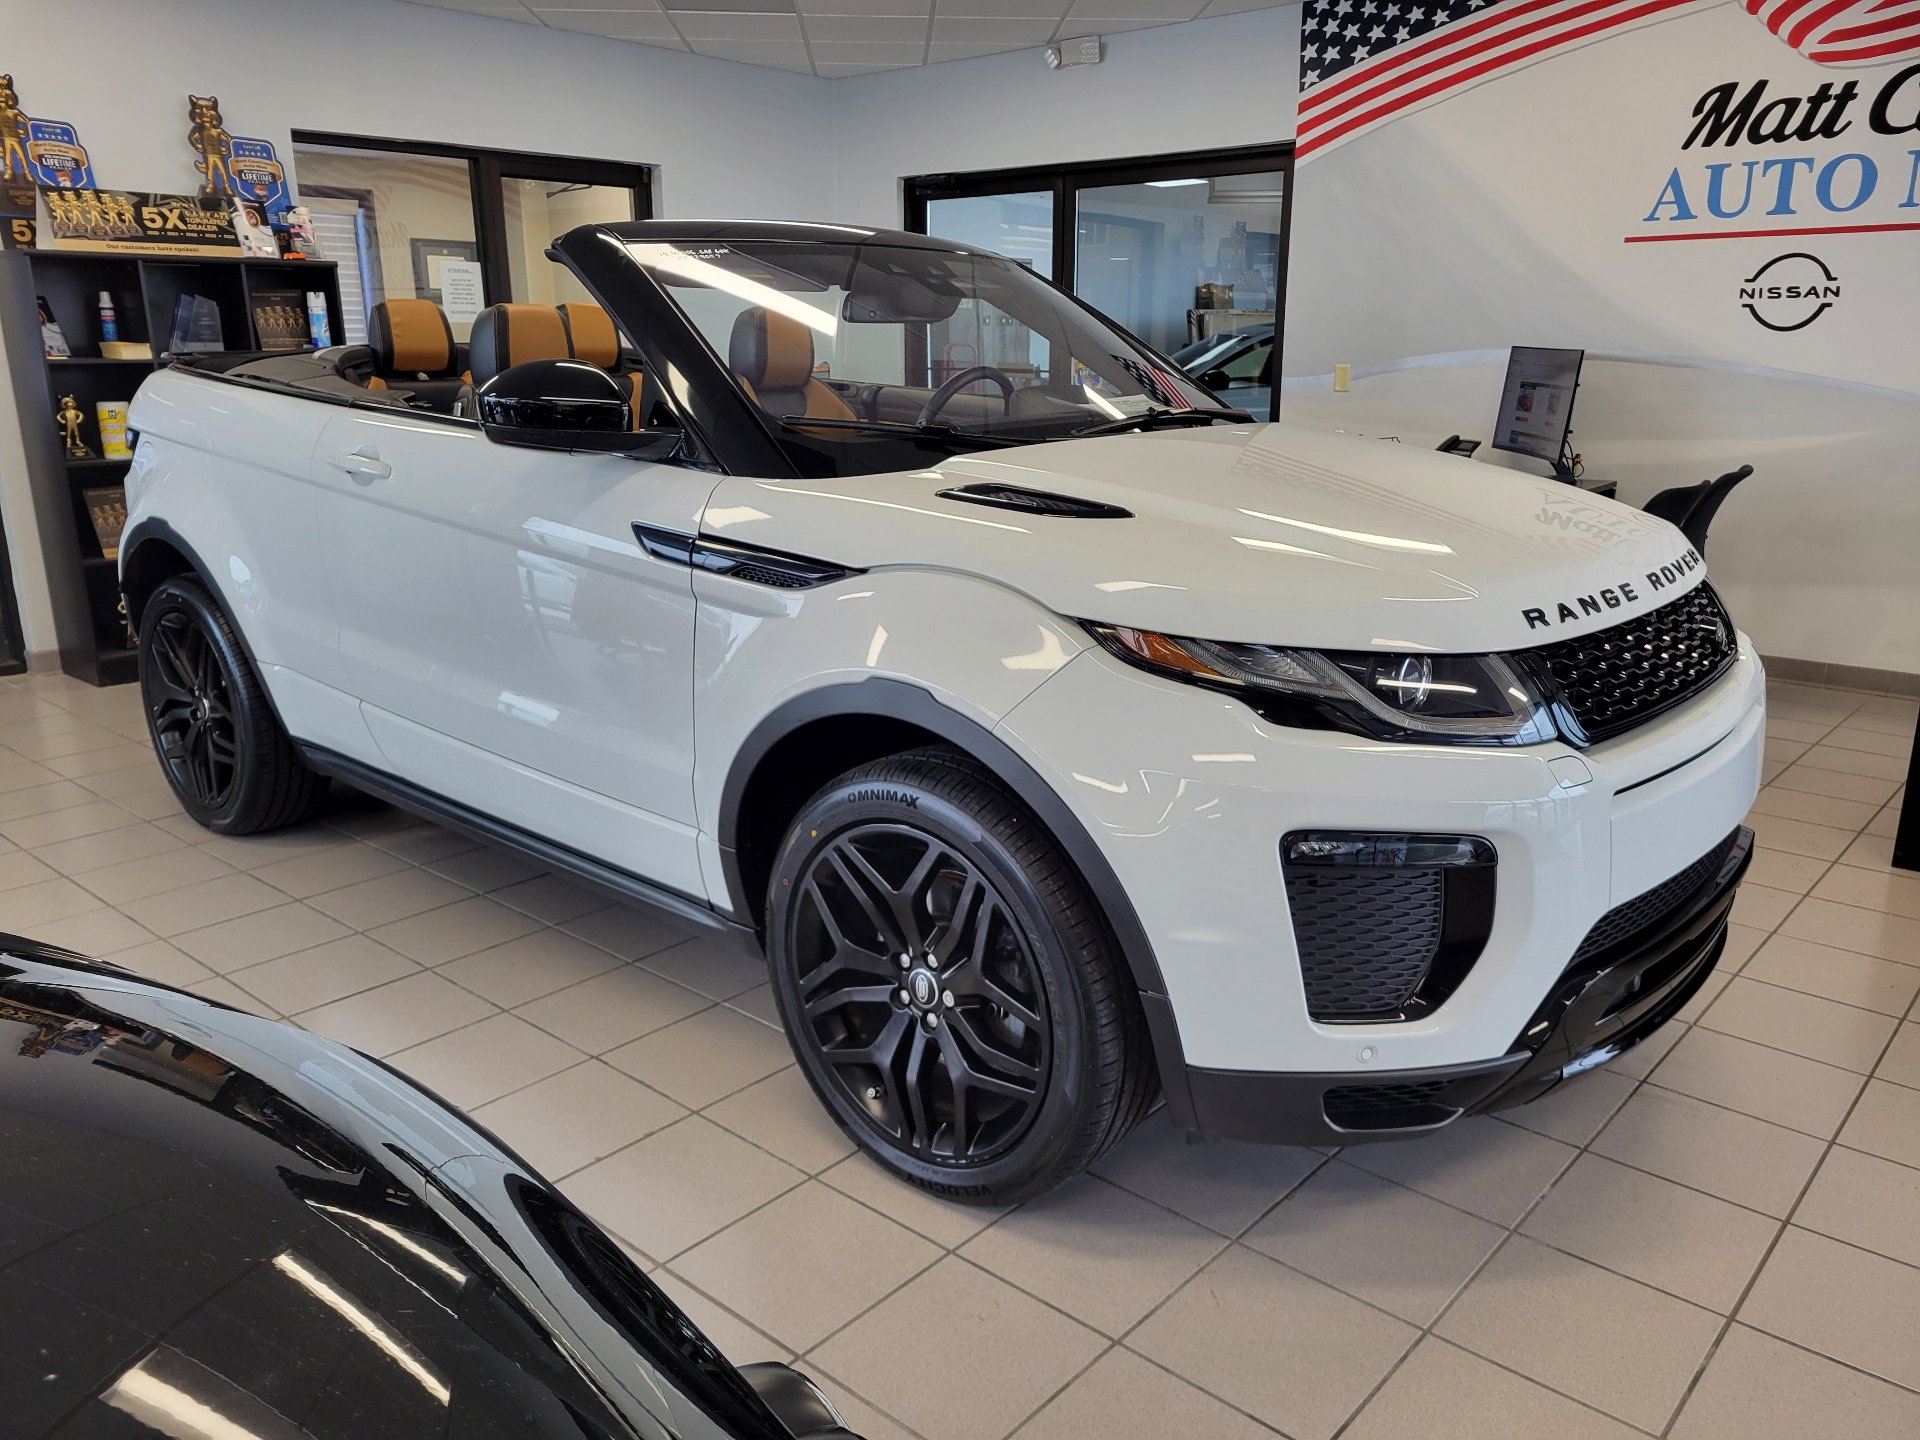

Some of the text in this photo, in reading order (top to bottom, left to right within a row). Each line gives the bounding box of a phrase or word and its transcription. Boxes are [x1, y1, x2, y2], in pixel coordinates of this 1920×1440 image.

[1681, 79, 1860, 151] Matt
[241, 172, 274, 182] LIFETIME
[1642, 153, 1879, 222] AUTO
[142, 207, 188, 229] 5X
[185, 217, 228, 225] TOP-RATED
[1739, 285, 1841, 300] NISSAN
[1521, 547, 1701, 630] RANGE ROVER
[847, 788, 920, 810] OMNIMAX
